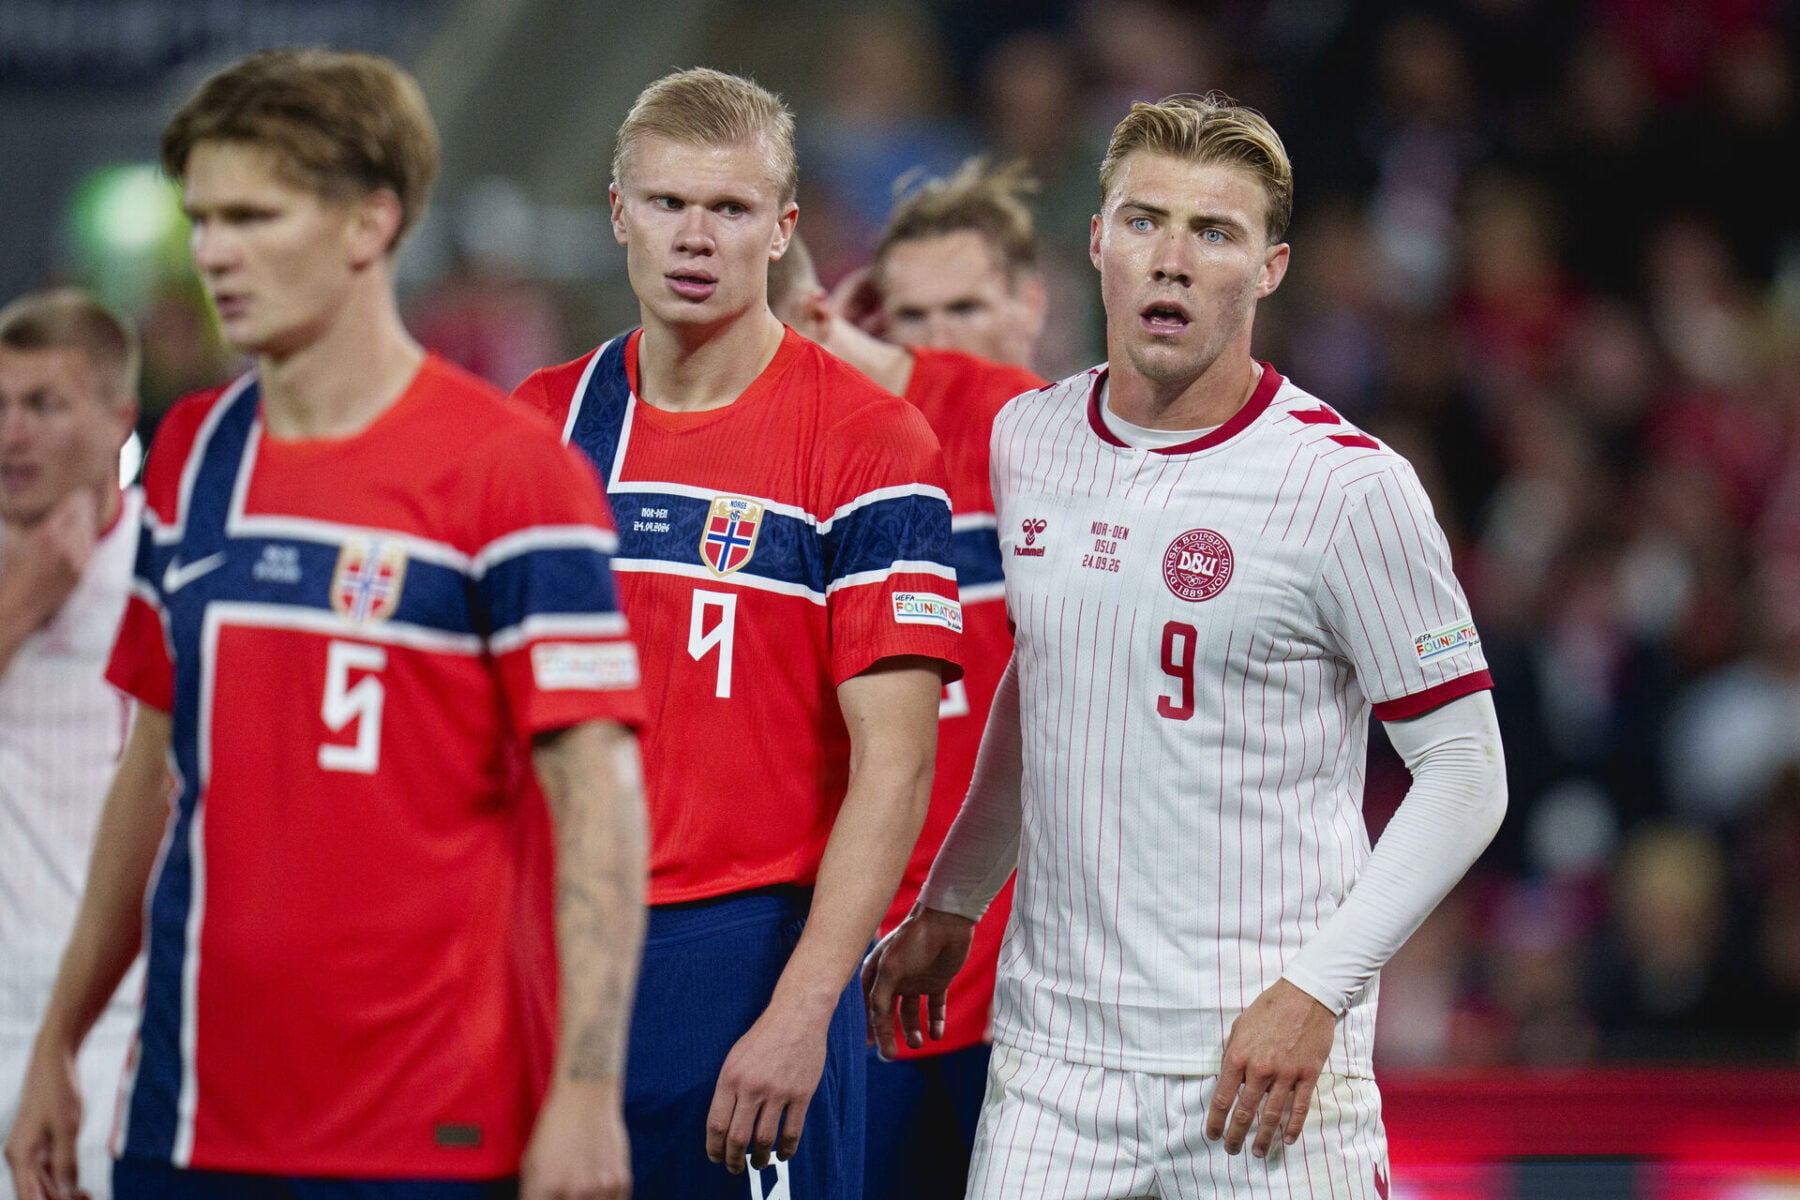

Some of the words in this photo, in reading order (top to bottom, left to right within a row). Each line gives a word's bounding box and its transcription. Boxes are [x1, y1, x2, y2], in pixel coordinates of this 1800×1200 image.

[1090, 520, 1130, 541] NOR-DEN
[1013, 544, 1046, 557] hummel
[1094, 538, 1117, 555] OSLO
[1081, 553, 1121, 573] 24.09.26
[1166, 544, 1181, 585] DANSK
[1207, 558, 1229, 593] UNION
[1177, 550, 1218, 577] DBU
[894, 593, 915, 601] UEFA
[1177, 585, 1204, 597] 1889
[895, 601, 961, 623] FOUNDATION
[687, 588, 738, 698] 9
[1414, 633, 1432, 645] UEFA
[1157, 620, 1198, 721] 9
[318, 639, 388, 775] 5
